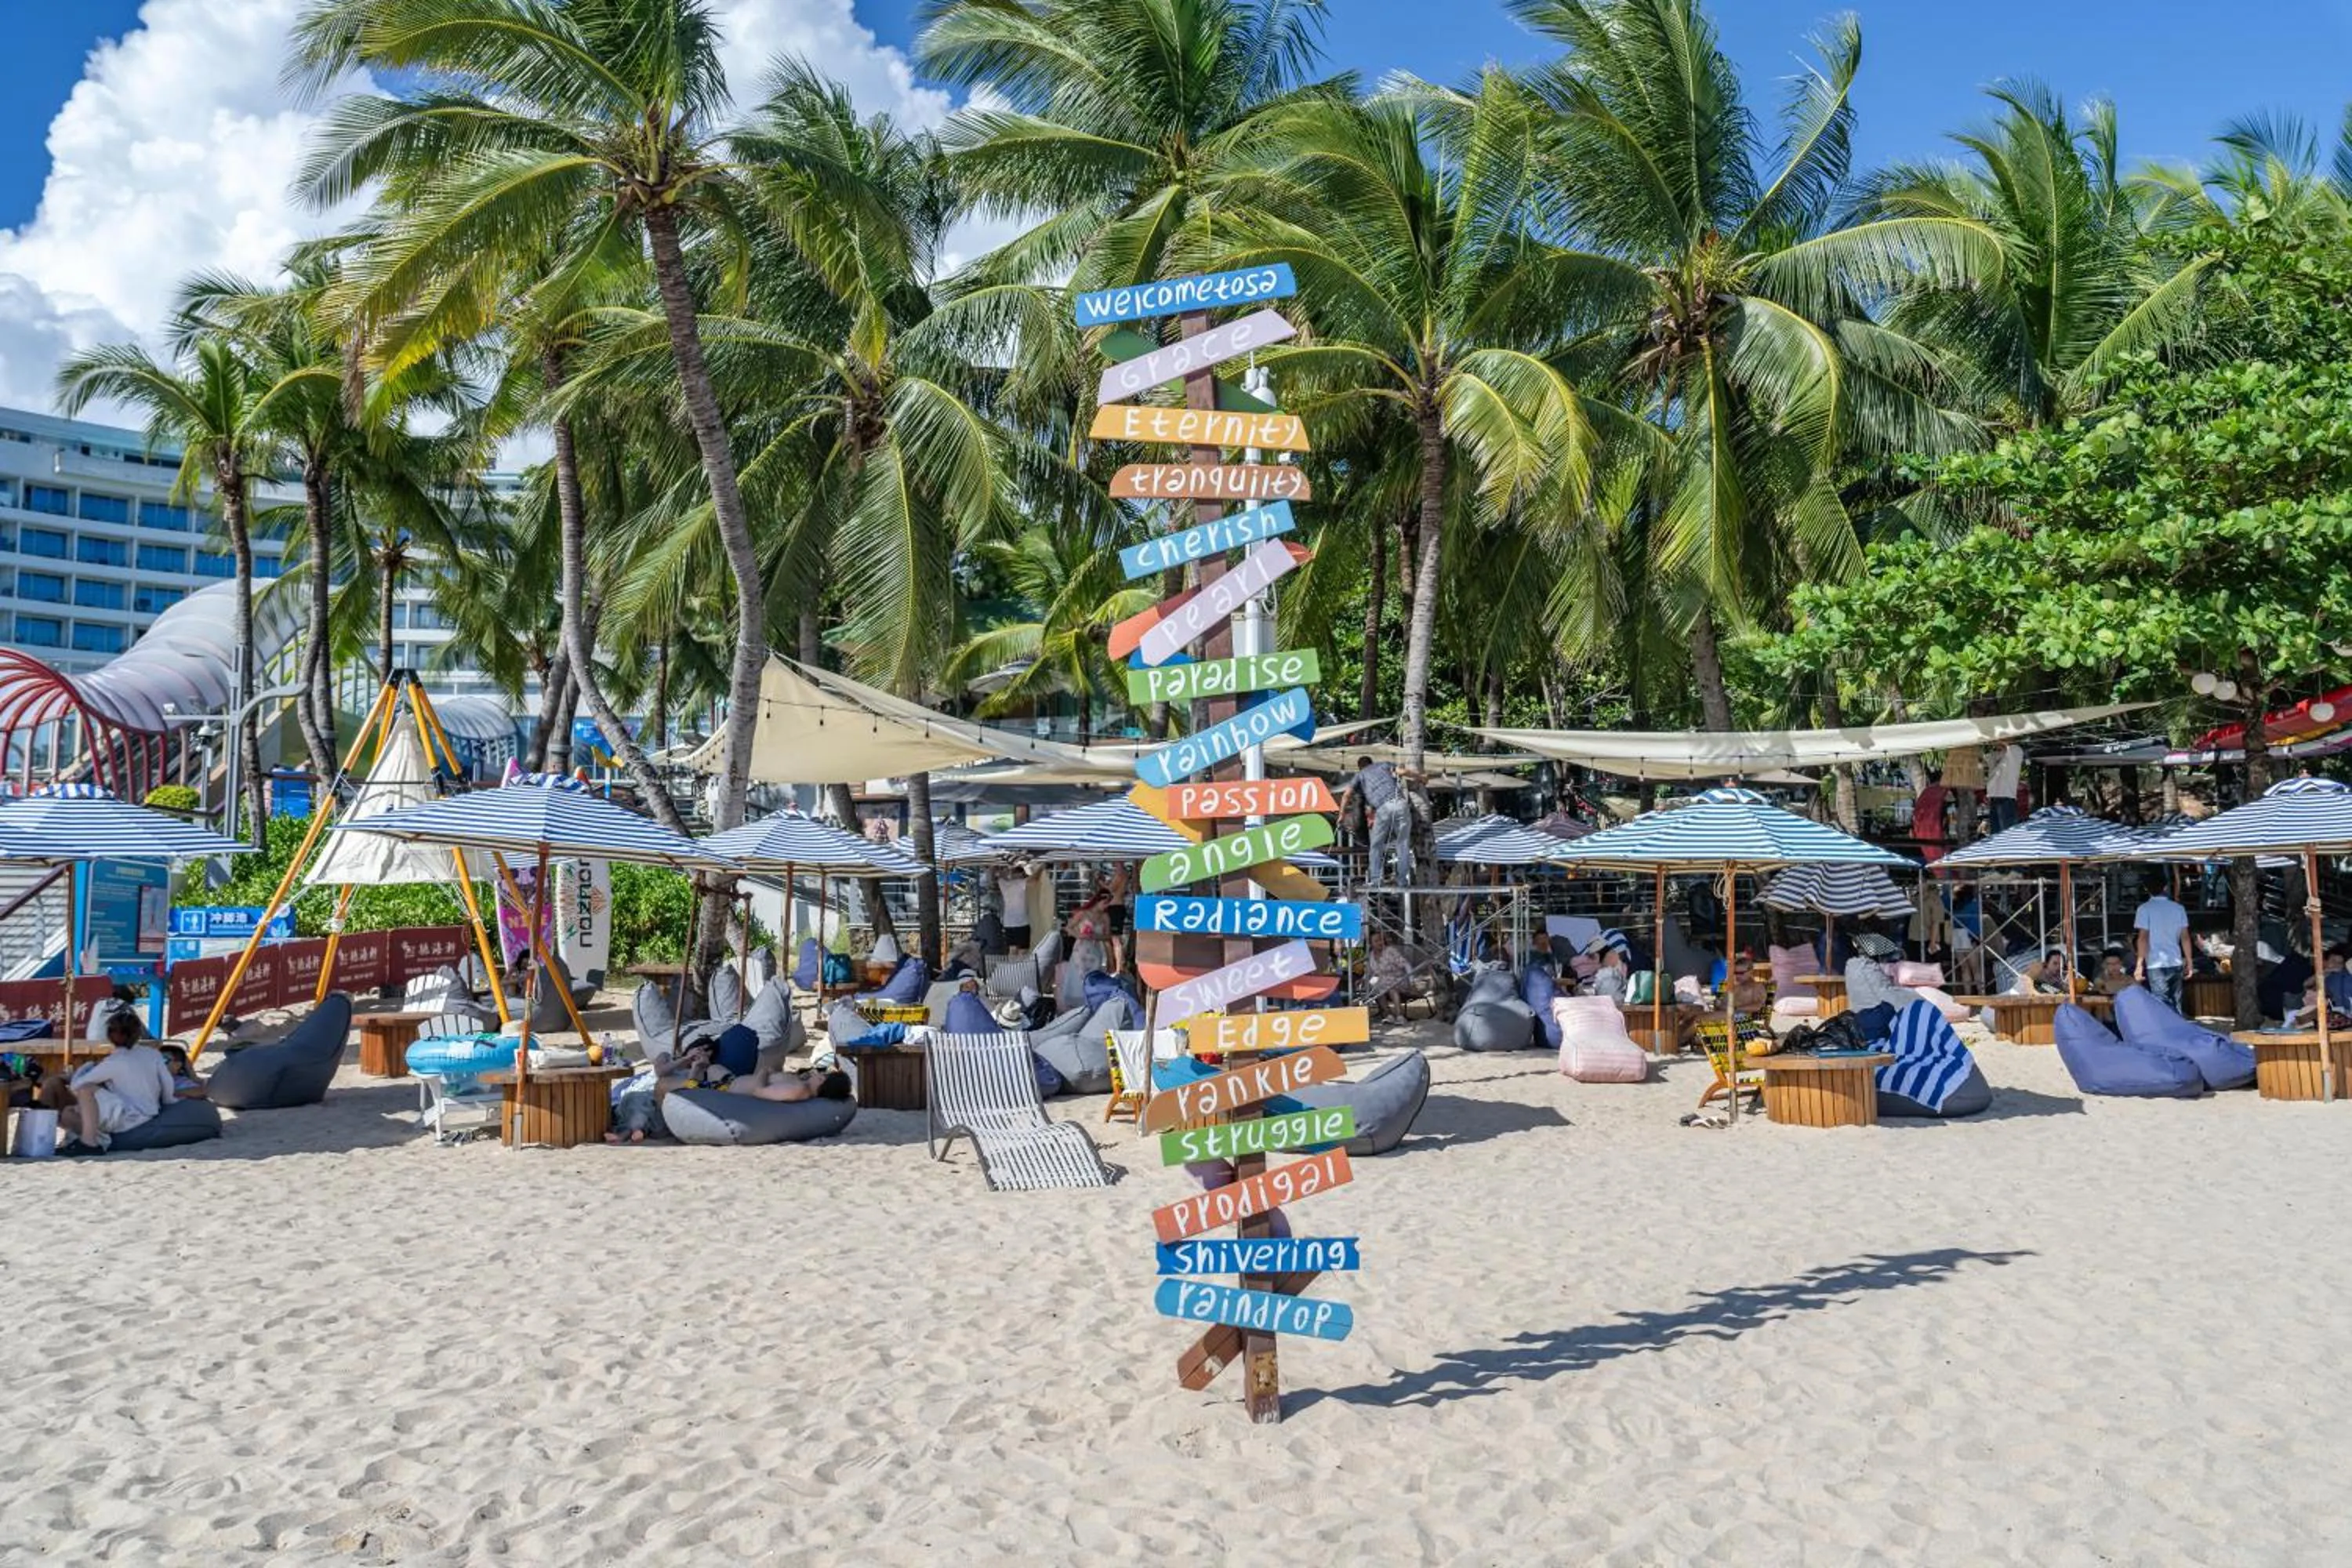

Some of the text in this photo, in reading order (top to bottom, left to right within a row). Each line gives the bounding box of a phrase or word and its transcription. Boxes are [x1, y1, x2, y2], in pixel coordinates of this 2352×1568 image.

[1124, 408, 1300, 445] Eternity
[1138, 510, 1278, 567] cherish
[1156, 695, 1296, 784] rainbow
[1169, 823, 1301, 886] angle
[1154, 899, 1343, 935] Radiance
[1217, 1014, 1327, 1049] Edge
[1177, 1056, 1313, 1121] rankle
[1177, 1282, 1332, 1336] raindrop
